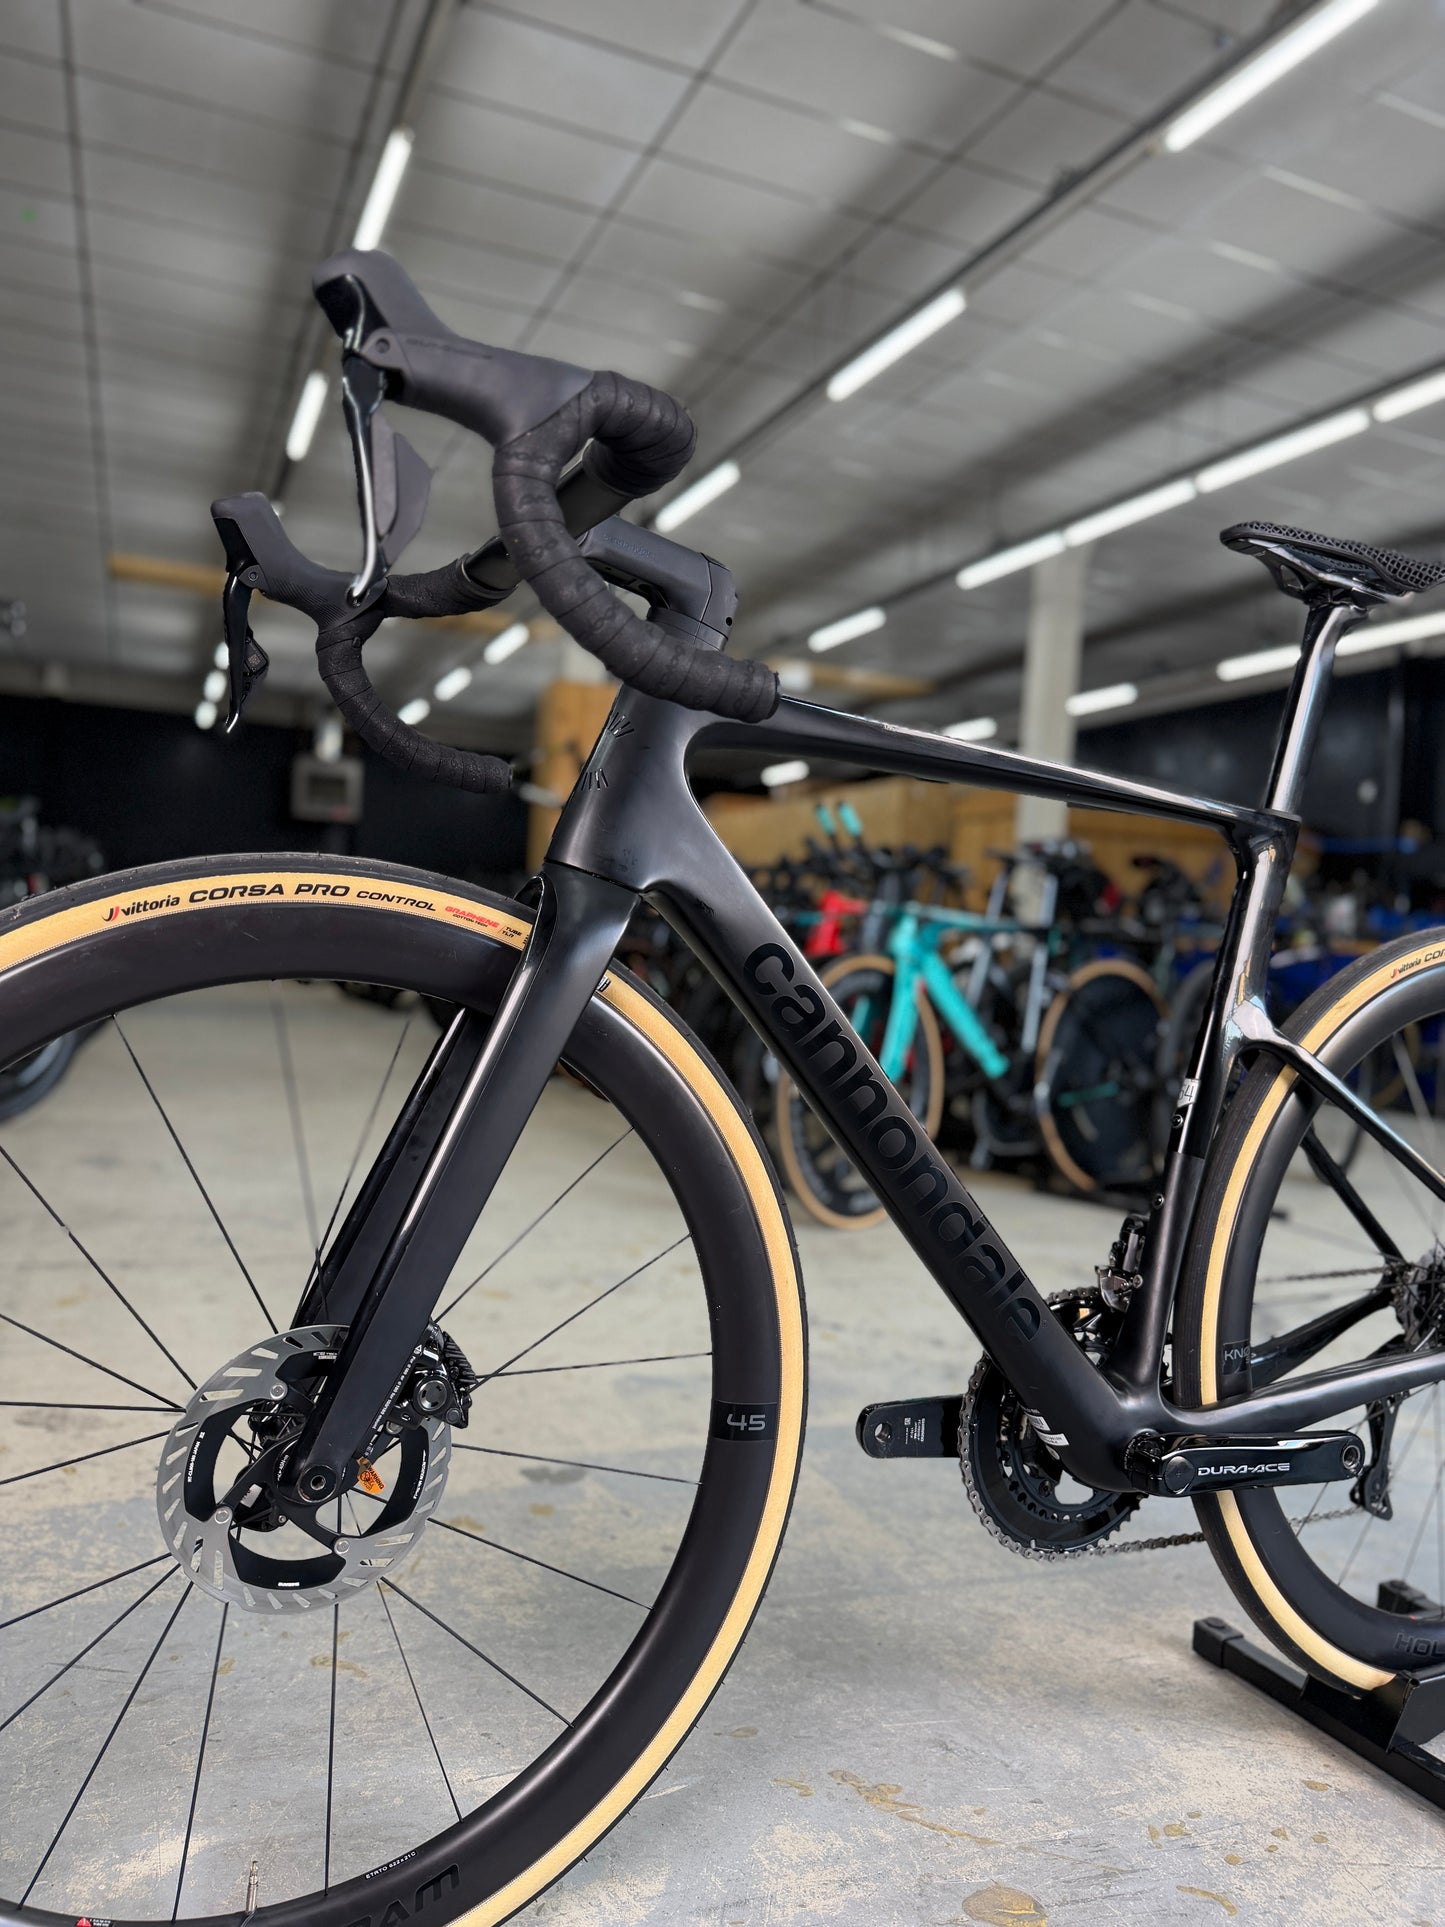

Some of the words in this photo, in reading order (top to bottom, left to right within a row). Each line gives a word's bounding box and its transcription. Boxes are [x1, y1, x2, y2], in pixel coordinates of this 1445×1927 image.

[121, 894, 180, 916] vittoria
[189, 883, 284, 903] CORSA
[294, 883, 350, 897] PRO
[356, 890, 436, 912] CONTROL
[445, 905, 500, 928] GRAPHENE
[743, 942, 1043, 1344] cannondale
[726, 1413, 766, 1431] 45
[1197, 1462, 1291, 1476] DURA-ACE
[365, 1865, 388, 1879] ETRTO
